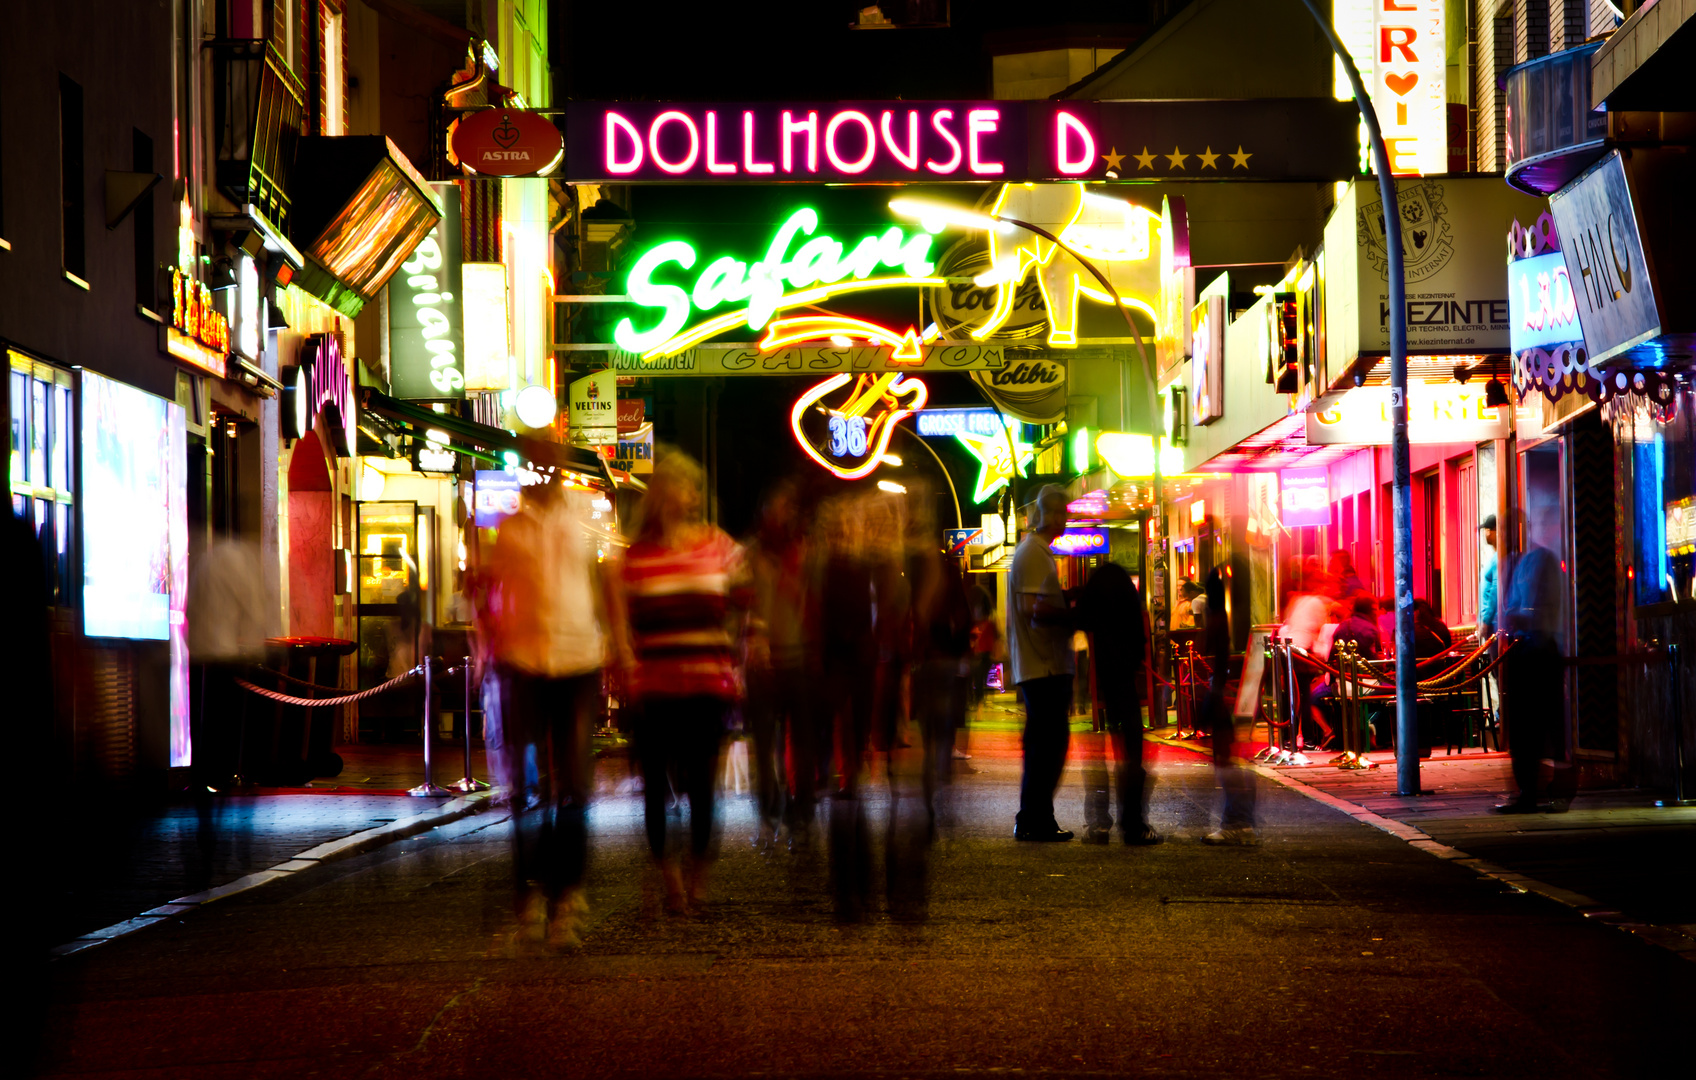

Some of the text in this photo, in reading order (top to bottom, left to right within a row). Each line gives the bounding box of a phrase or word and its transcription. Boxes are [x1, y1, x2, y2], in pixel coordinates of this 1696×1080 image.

[605, 110, 1096, 174] DOLLHOUSE D
[482, 151, 530, 160] ASTRA
[1365, 187, 1419, 214] BLANESE
[1408, 246, 1450, 278] INTERNAT
[1572, 212, 1633, 314] HALO
[613, 207, 946, 353] Safari
[1420, 325, 1452, 333] TECHNO,
[1453, 324, 1489, 332] ELECTRO,
[1406, 337, 1475, 346] ww.kiezinternat.de
[991, 361, 1058, 386] Colibri
[575, 401, 612, 411] VELTINS
[617, 408, 641, 422] otel
[919, 414, 966, 434] GROSSE
[828, 416, 867, 457] 36
[1053, 534, 1105, 547] ASINO
